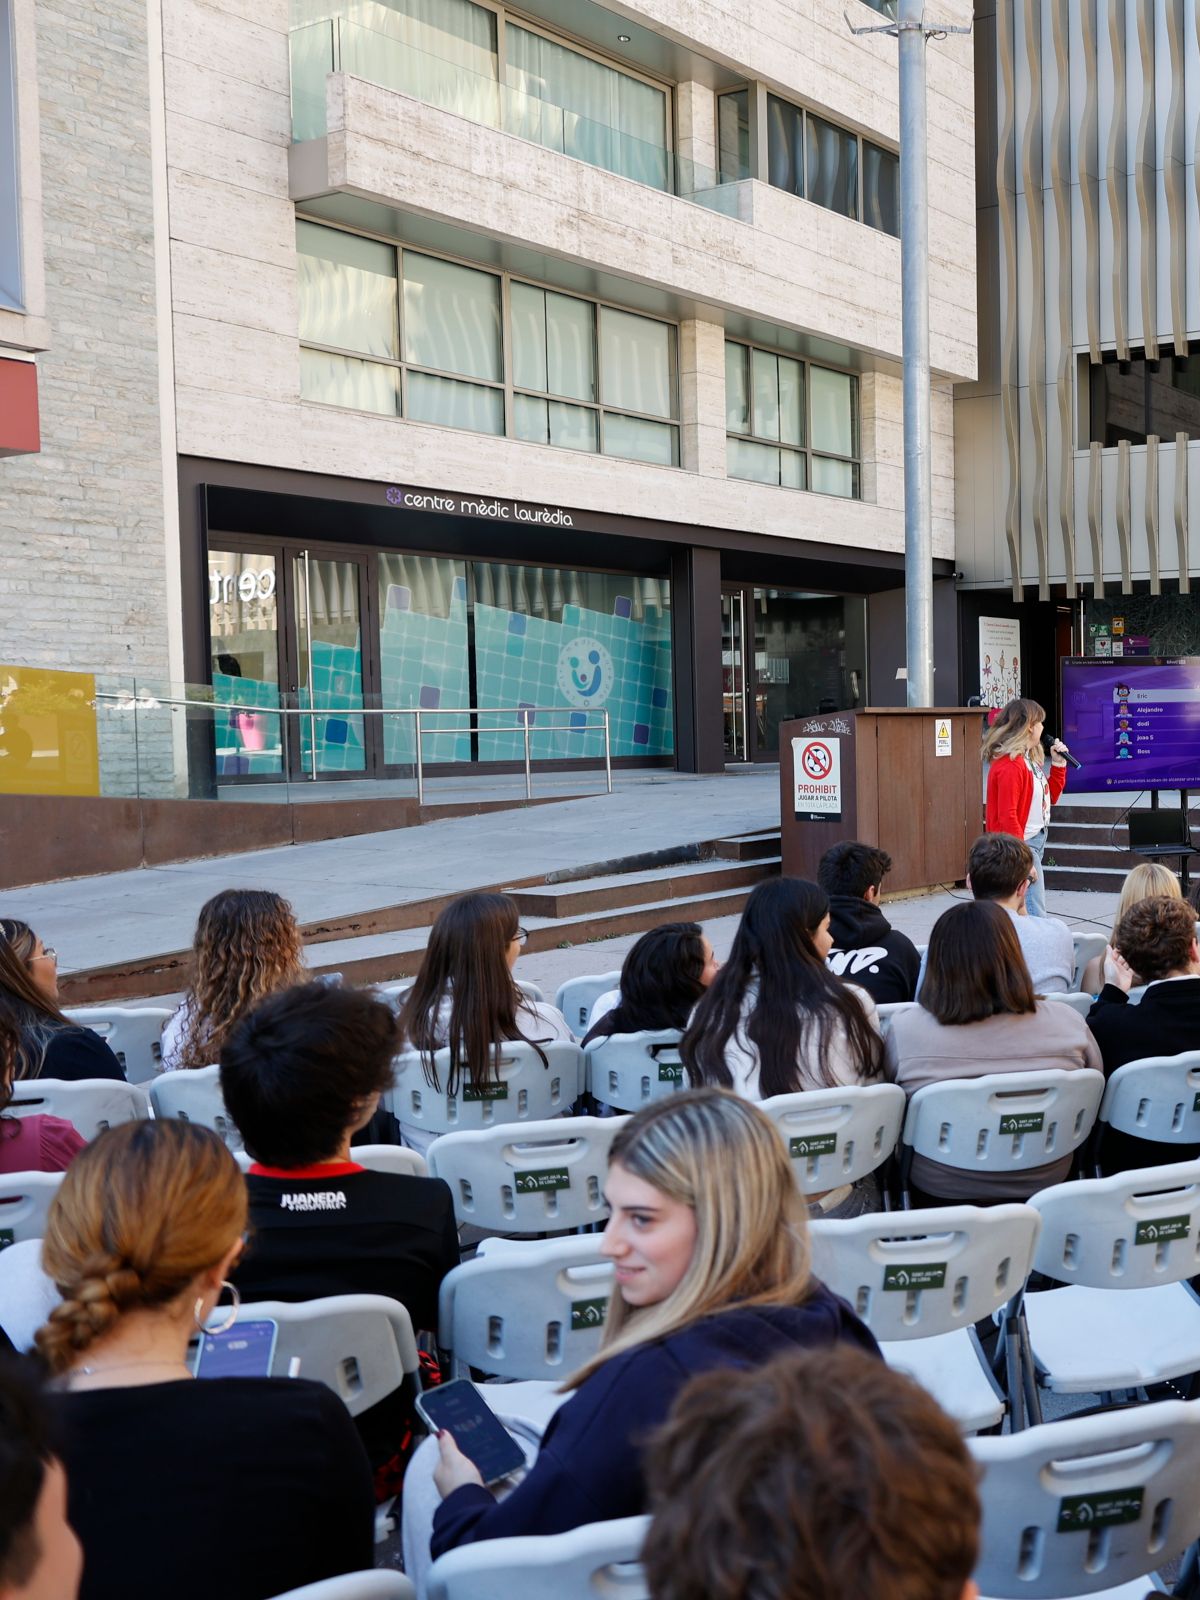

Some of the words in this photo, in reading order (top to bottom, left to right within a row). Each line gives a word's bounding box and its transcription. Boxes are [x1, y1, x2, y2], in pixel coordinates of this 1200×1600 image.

[404, 493, 456, 511] centre
[460, 499, 510, 518] mèdic
[514, 503, 574, 526] laurèdia
[1137, 706, 1163, 714] Alejandro
[798, 784, 837, 794] PROHIBIT
[280, 1190, 347, 1208] JUANEDA
